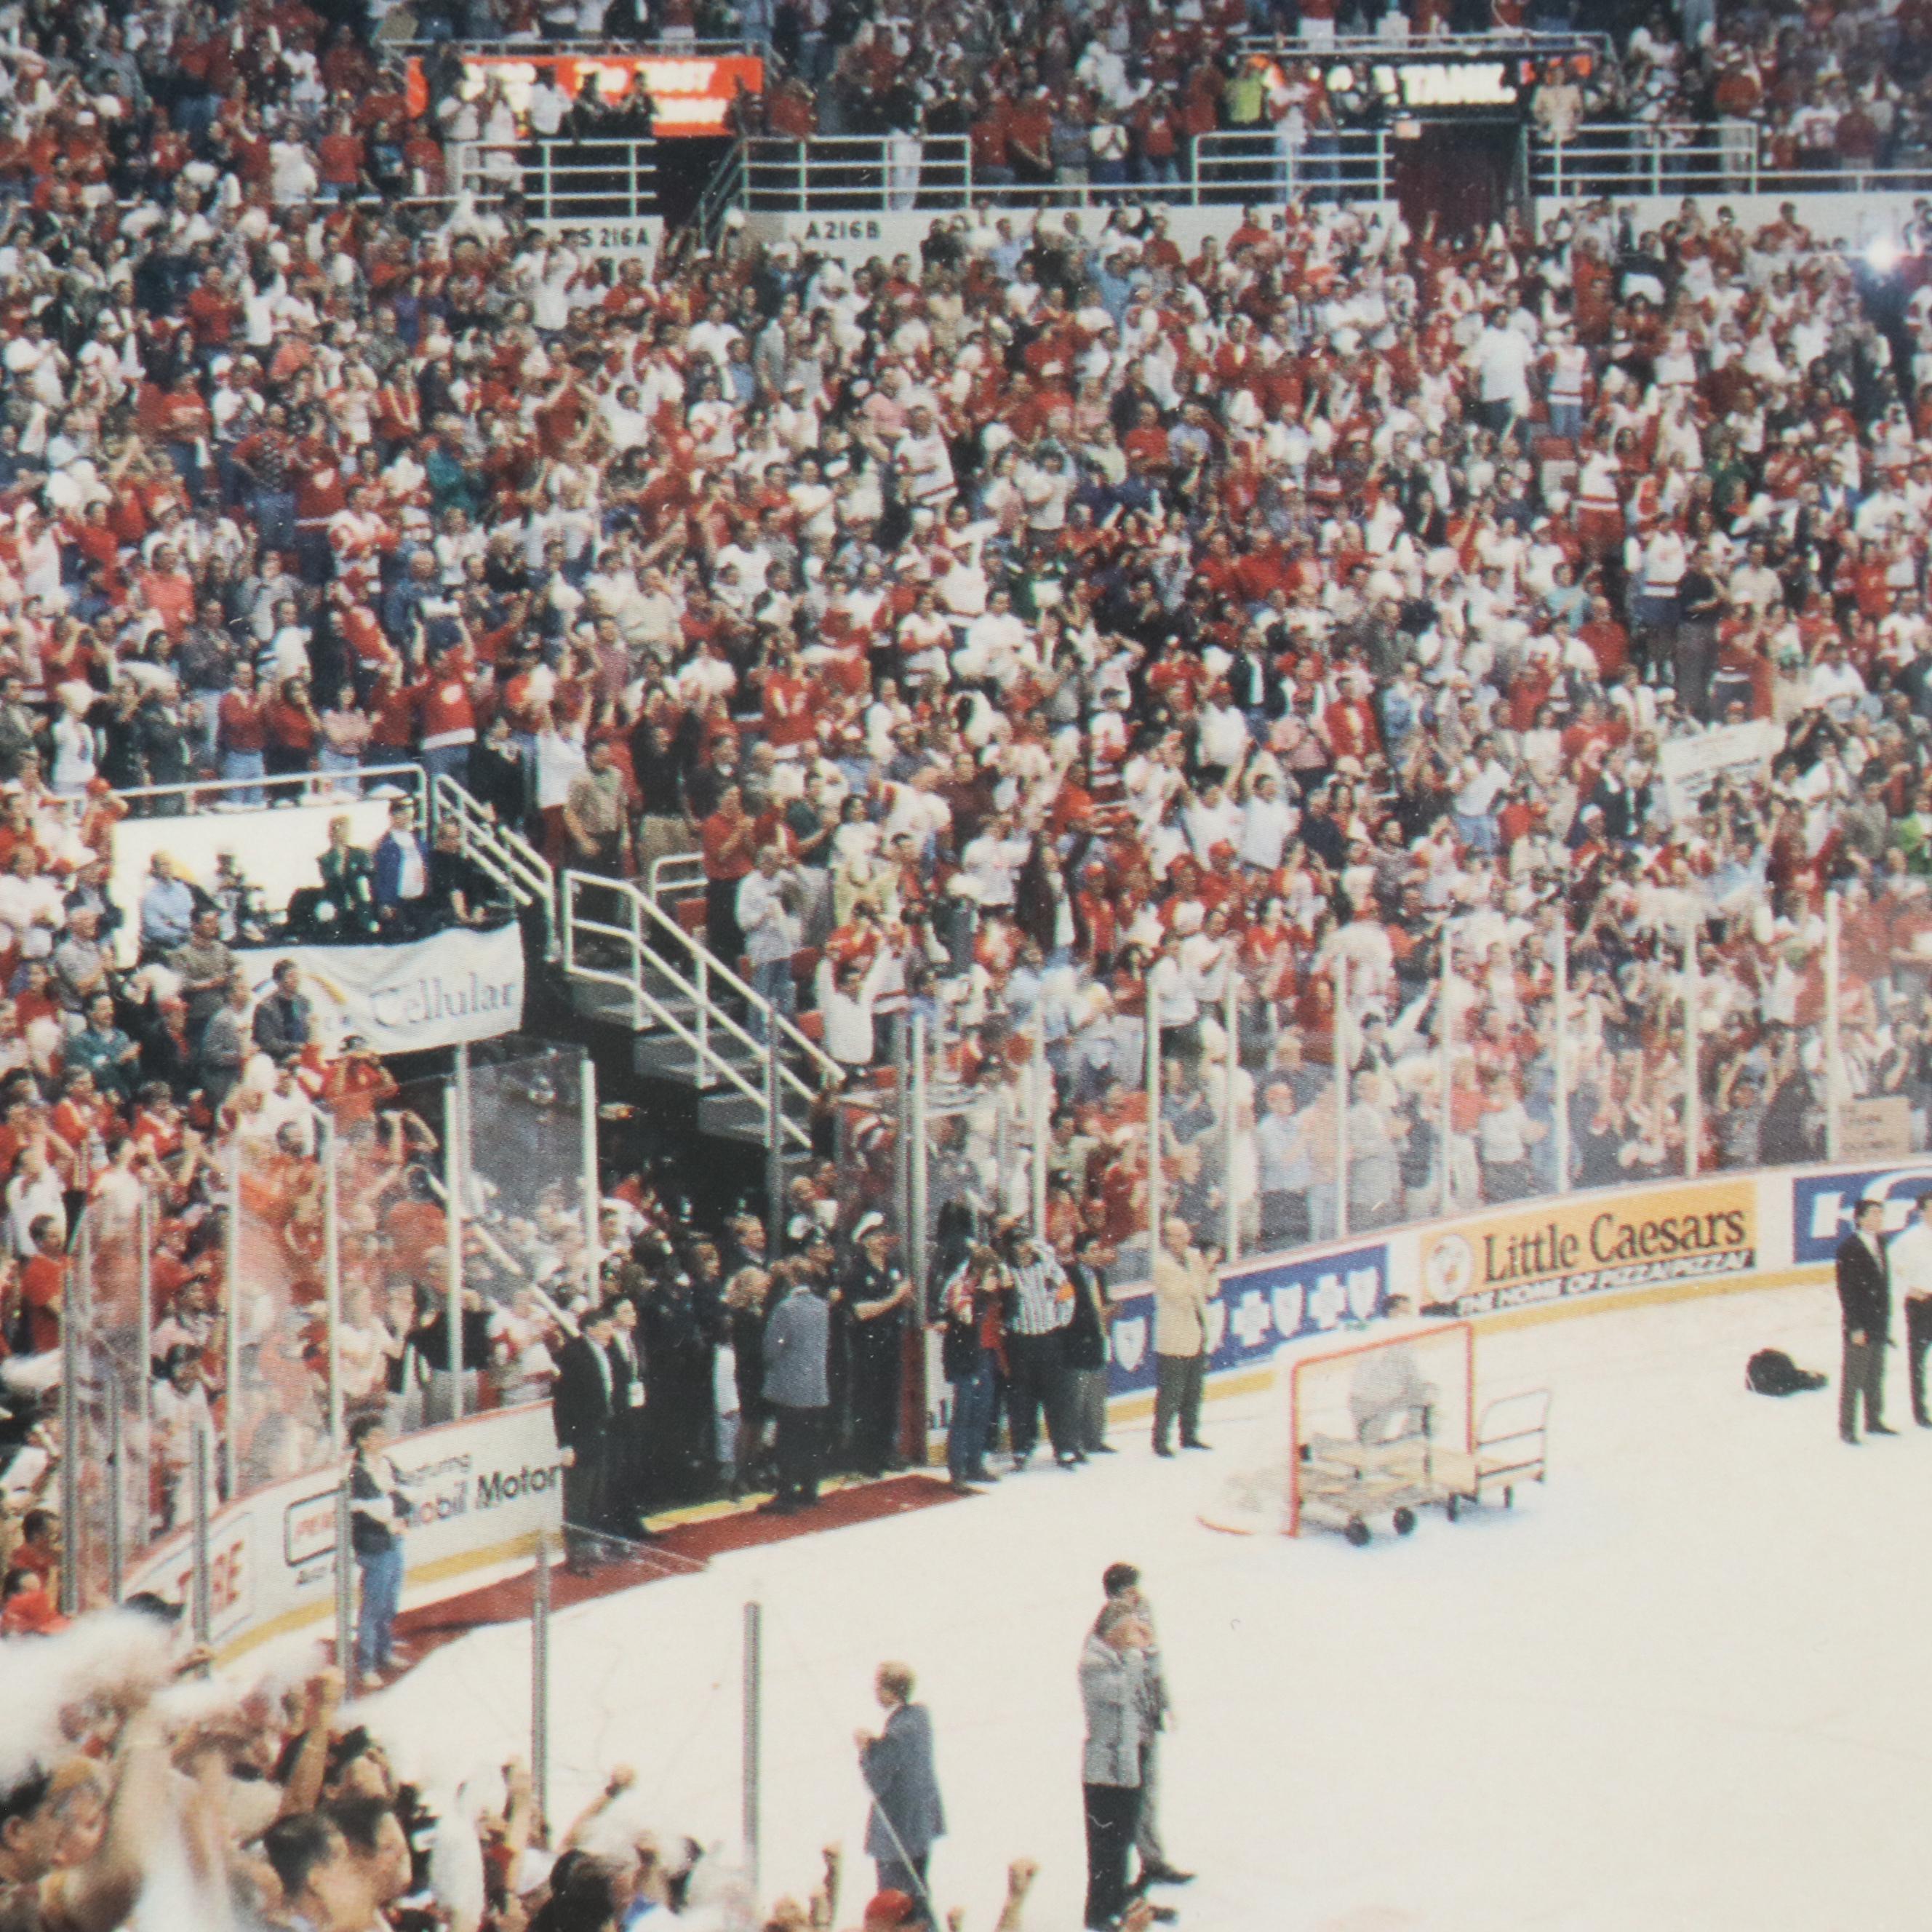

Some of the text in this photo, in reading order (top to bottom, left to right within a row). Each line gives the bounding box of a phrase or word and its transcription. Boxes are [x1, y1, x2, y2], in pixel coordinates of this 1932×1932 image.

[369, 970, 514, 1028] Cellular
[1482, 1223, 1578, 1282] Little
[1589, 1210, 1746, 1263] Caesars
[410, 1464, 563, 1527] obil Motor
